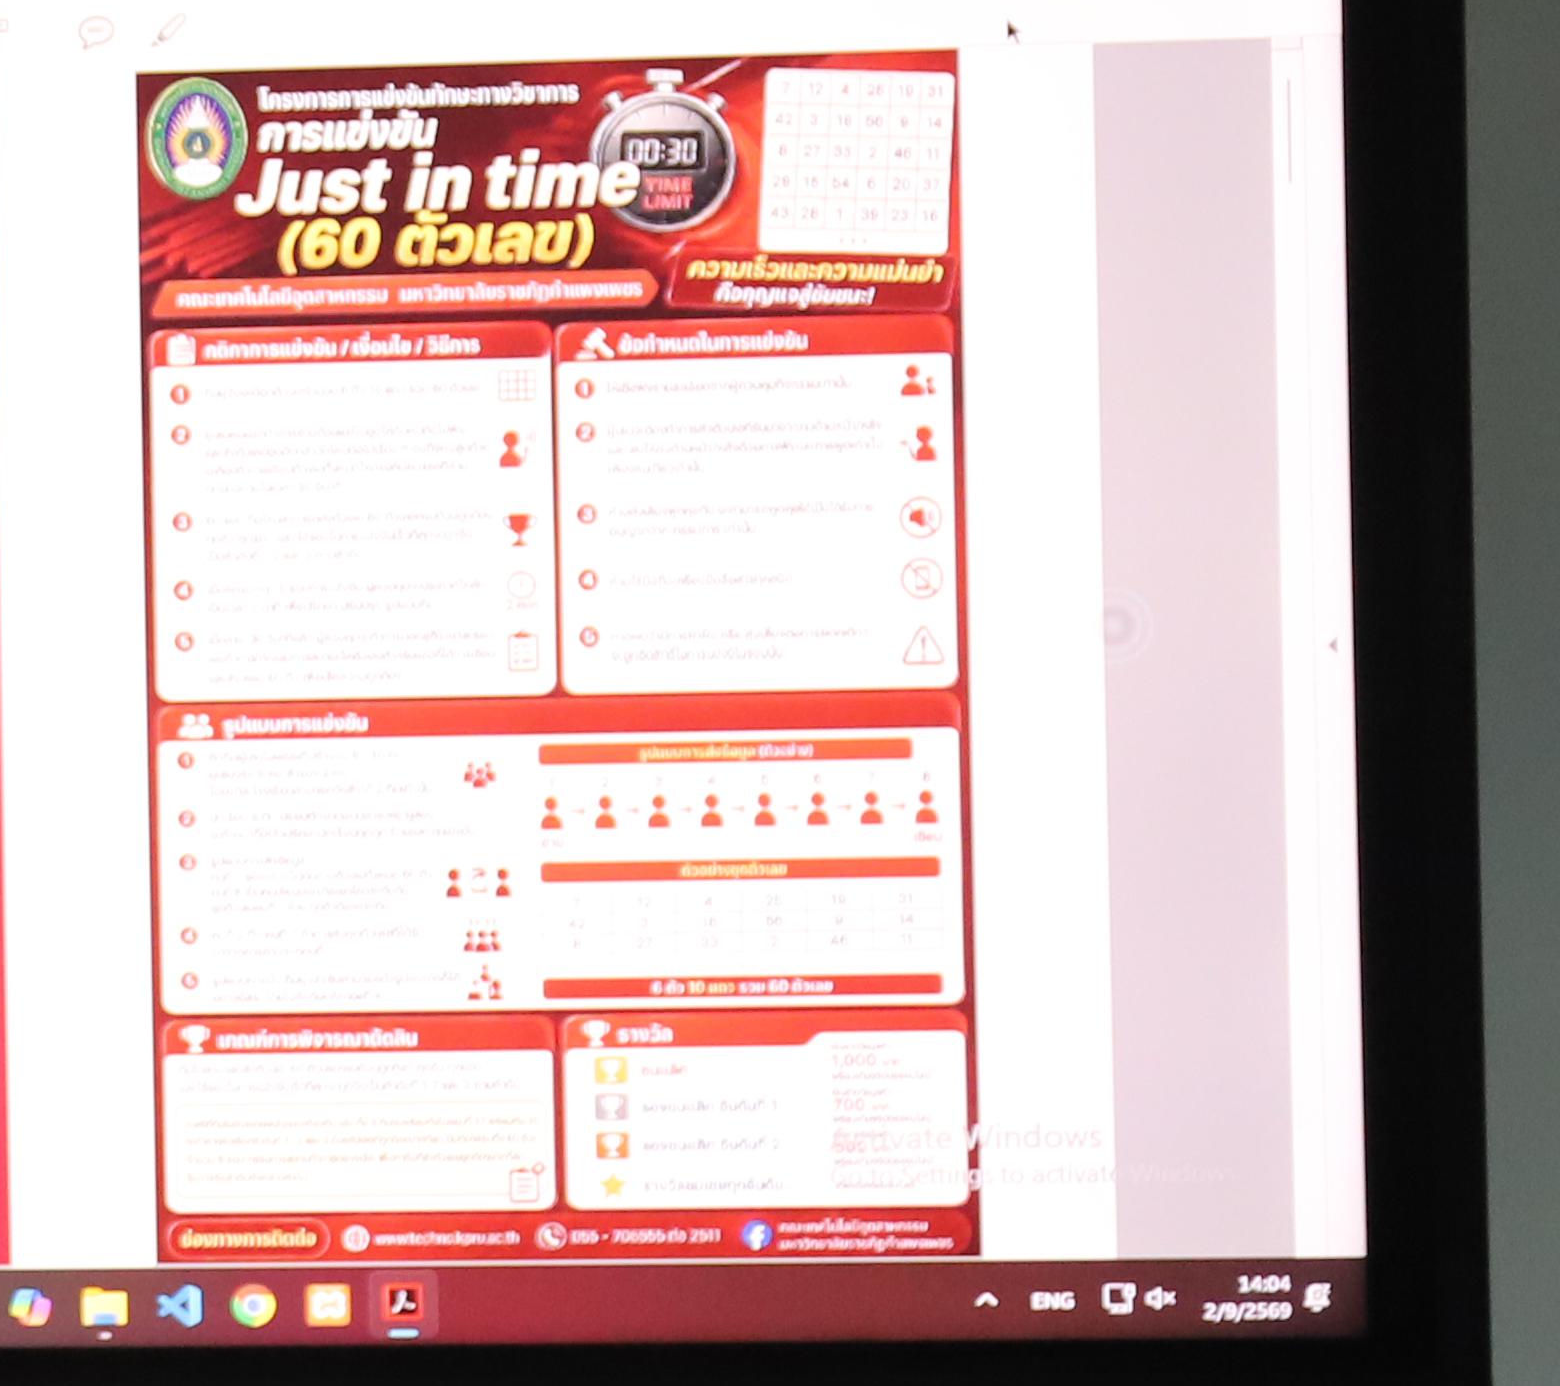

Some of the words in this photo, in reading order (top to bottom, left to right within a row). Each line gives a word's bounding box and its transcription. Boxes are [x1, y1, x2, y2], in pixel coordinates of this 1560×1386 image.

[257, 111, 440, 154] การแข่งขัน
[627, 136, 699, 167] 00:30
[234, 156, 393, 217] Just
[405, 149, 473, 213] in
[484, 147, 641, 211] time
[642, 175, 694, 194] TIME
[641, 194, 694, 212] LIMIT
[276, 215, 383, 277] (60
[394, 210, 595, 270] ตัวเลข)
[223, 712, 370, 739] รูปแบบการแข่งขัน
[617, 1022, 675, 1044] รางวัล
[1237, 1273, 1292, 1295] 14:04
[1029, 1291, 1077, 1311] ENG
[1202, 1301, 1294, 1324] 2/9/2569
